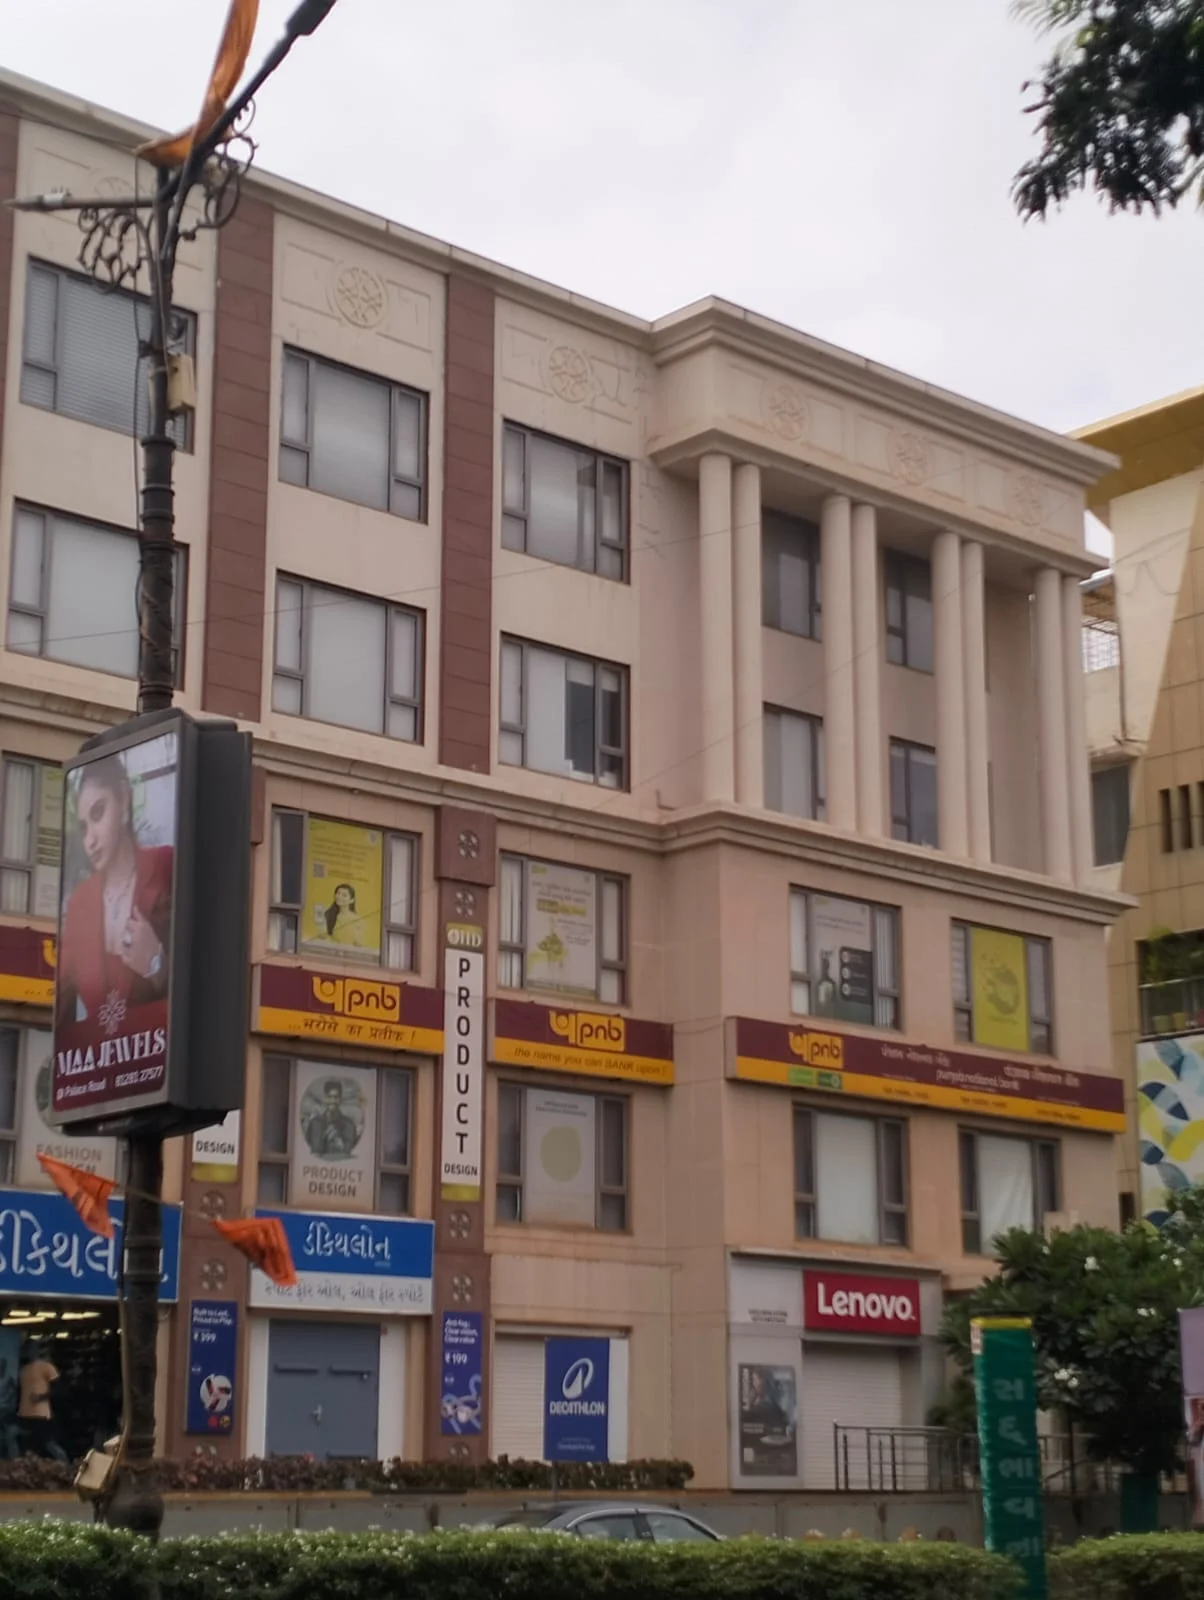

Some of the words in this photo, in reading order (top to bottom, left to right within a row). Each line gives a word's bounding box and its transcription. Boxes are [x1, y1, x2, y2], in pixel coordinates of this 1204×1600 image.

[348, 987, 397, 1012] pnb
[345, 1022, 361, 1037] का
[579, 1019, 622, 1044] pnb
[56, 1044, 95, 1078] MAA
[97, 1027, 166, 1068] JEWELS
[453, 957, 475, 1154] PRODUCT
[811, 1036, 841, 1061] pnb
[514, 1047, 531, 1057] the
[533, 1049, 561, 1061] name
[564, 1053, 582, 1065] you
[584, 1055, 602, 1067] can
[605, 1057, 634, 1073] BANK
[36, 1144, 101, 1162] FASHION
[196, 1140, 235, 1154] DESIGN
[302, 1164, 364, 1184] PRODUCT
[444, 1163, 478, 1176] DESIGN
[308, 1182, 356, 1198] DESIGN
[817, 1282, 912, 1321] Lenovo
[549, 1401, 605, 1415] DECATHLON
